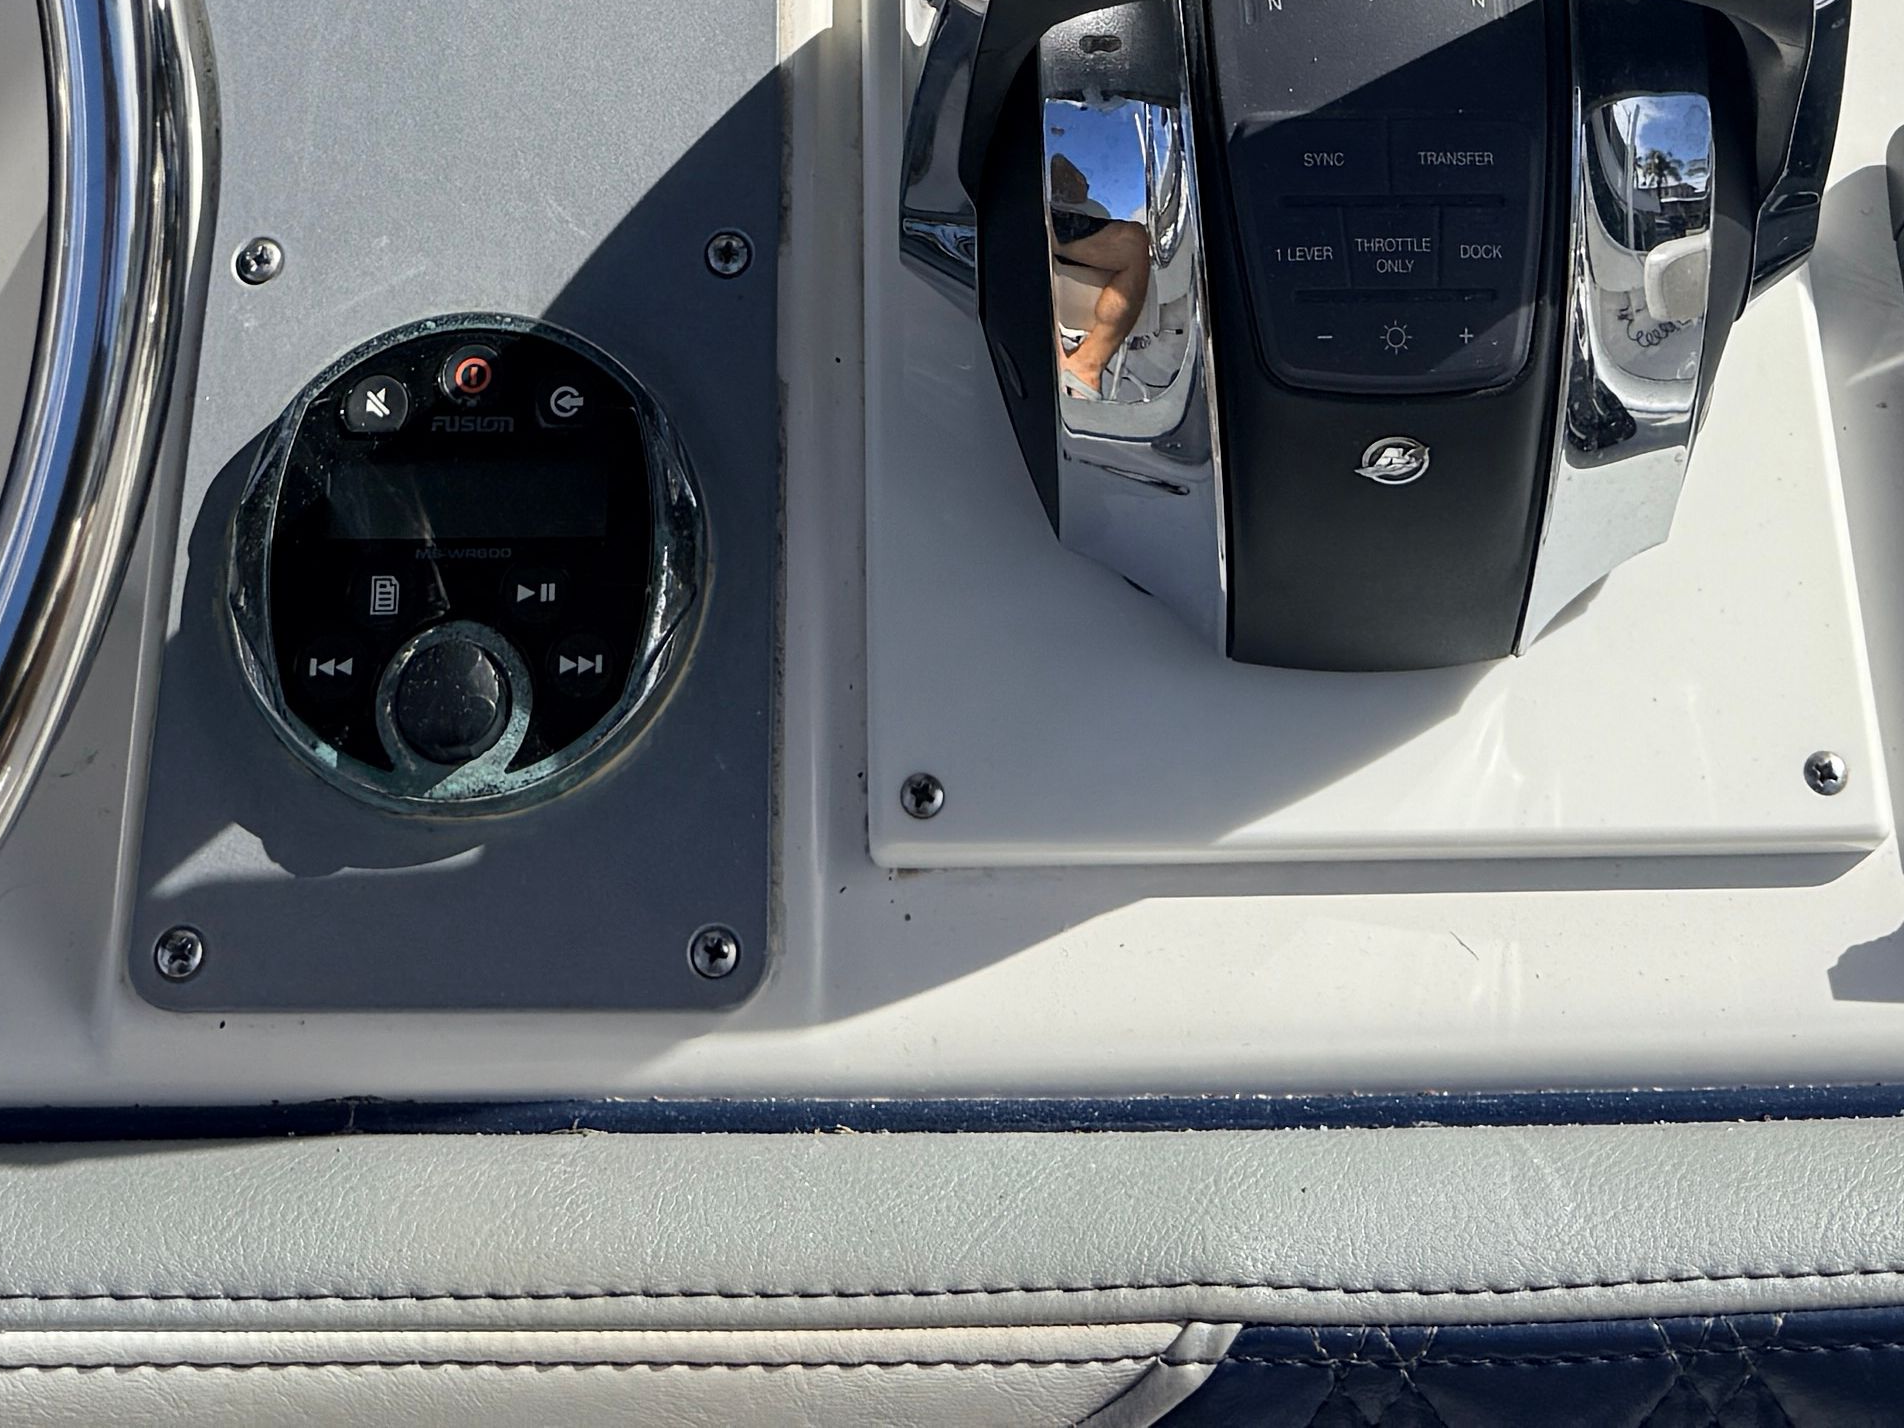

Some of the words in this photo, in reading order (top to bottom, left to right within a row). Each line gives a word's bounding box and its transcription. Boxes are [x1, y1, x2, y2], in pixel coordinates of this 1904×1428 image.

[1304, 151, 1346, 166] SYNC
[1418, 150, 1494, 166] TRANSFER
[1354, 237, 1432, 253] THROTTLE
[1459, 243, 1503, 259] DOCK
[1275, 247, 1283, 261] 1
[1287, 246, 1333, 261] LEVER
[1376, 258, 1415, 274] ONLY
[431, 415, 515, 433] FUSION
